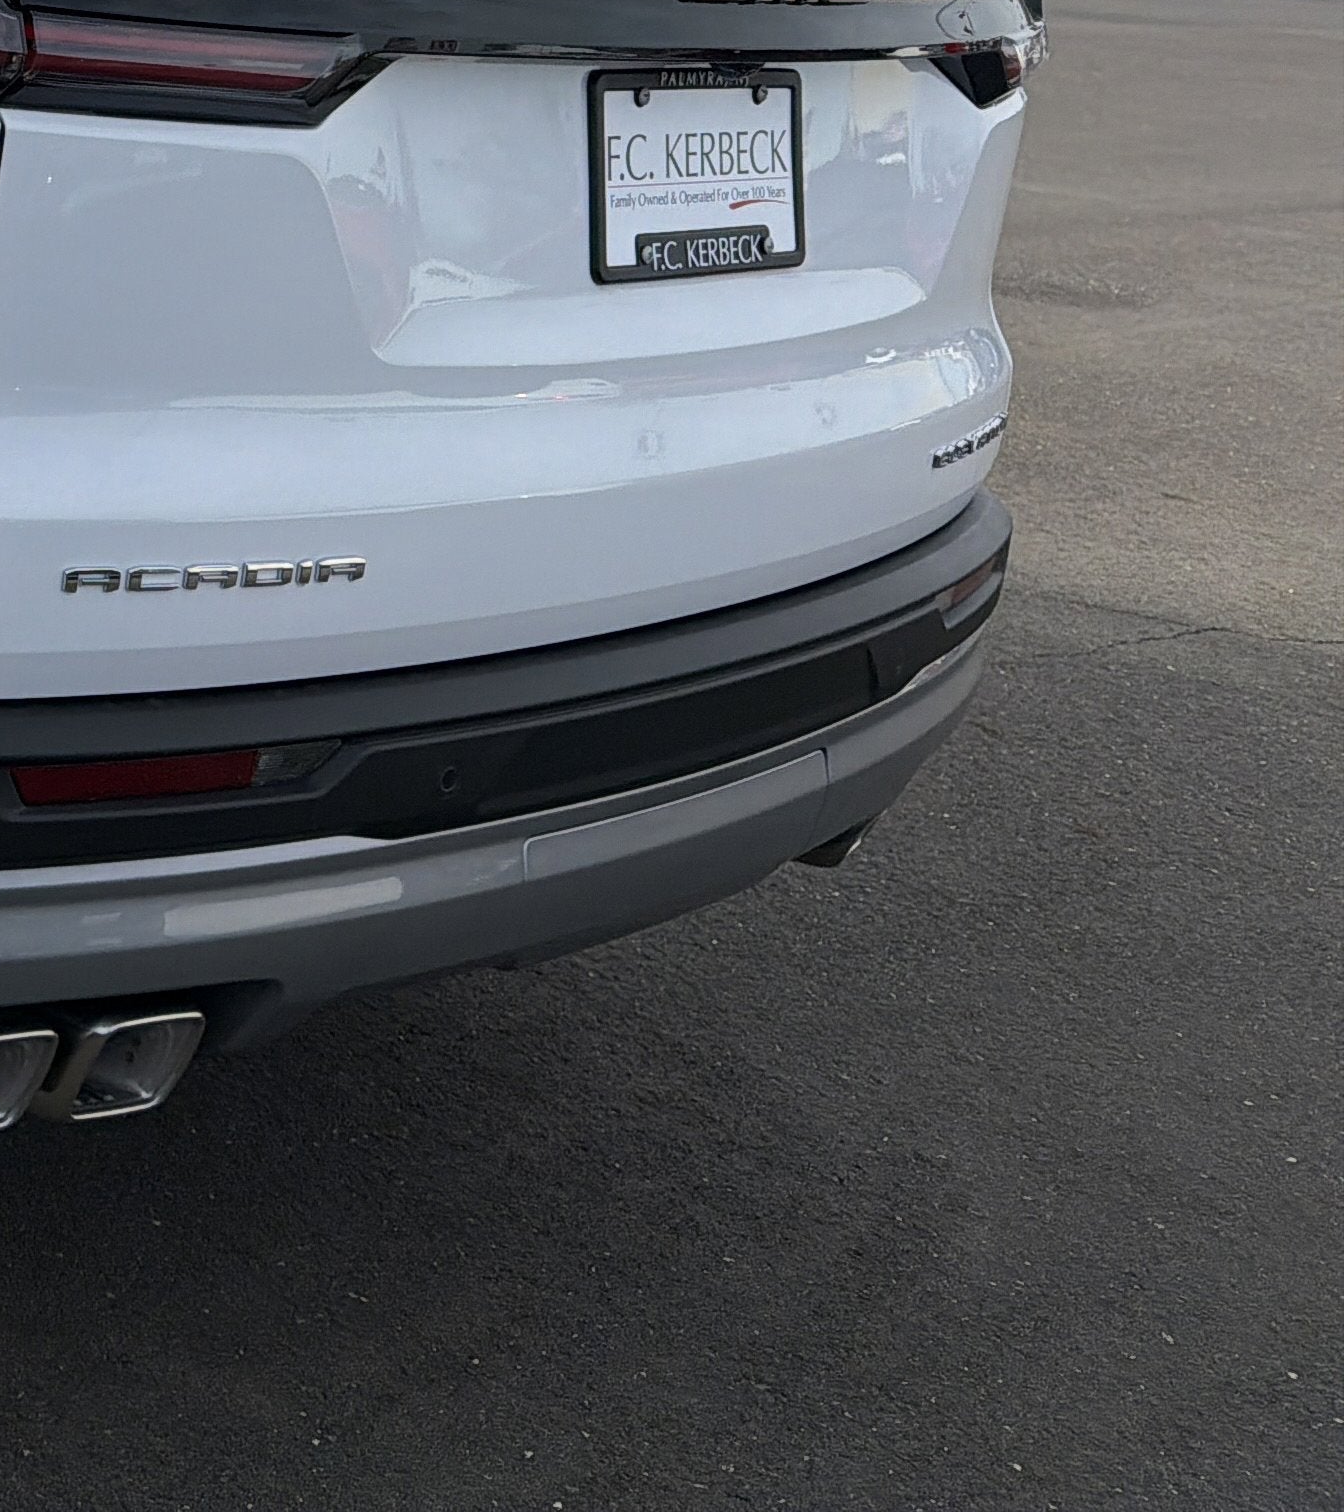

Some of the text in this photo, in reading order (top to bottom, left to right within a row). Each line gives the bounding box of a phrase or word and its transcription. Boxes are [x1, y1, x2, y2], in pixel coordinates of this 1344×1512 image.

[607, 129, 788, 182] F.C. KERBECK
[610, 186, 787, 210] Family Owned & Operated For Over 100 Years
[651, 233, 762, 271] F.C. KERBECK
[62, 555, 367, 593] ACADIA
